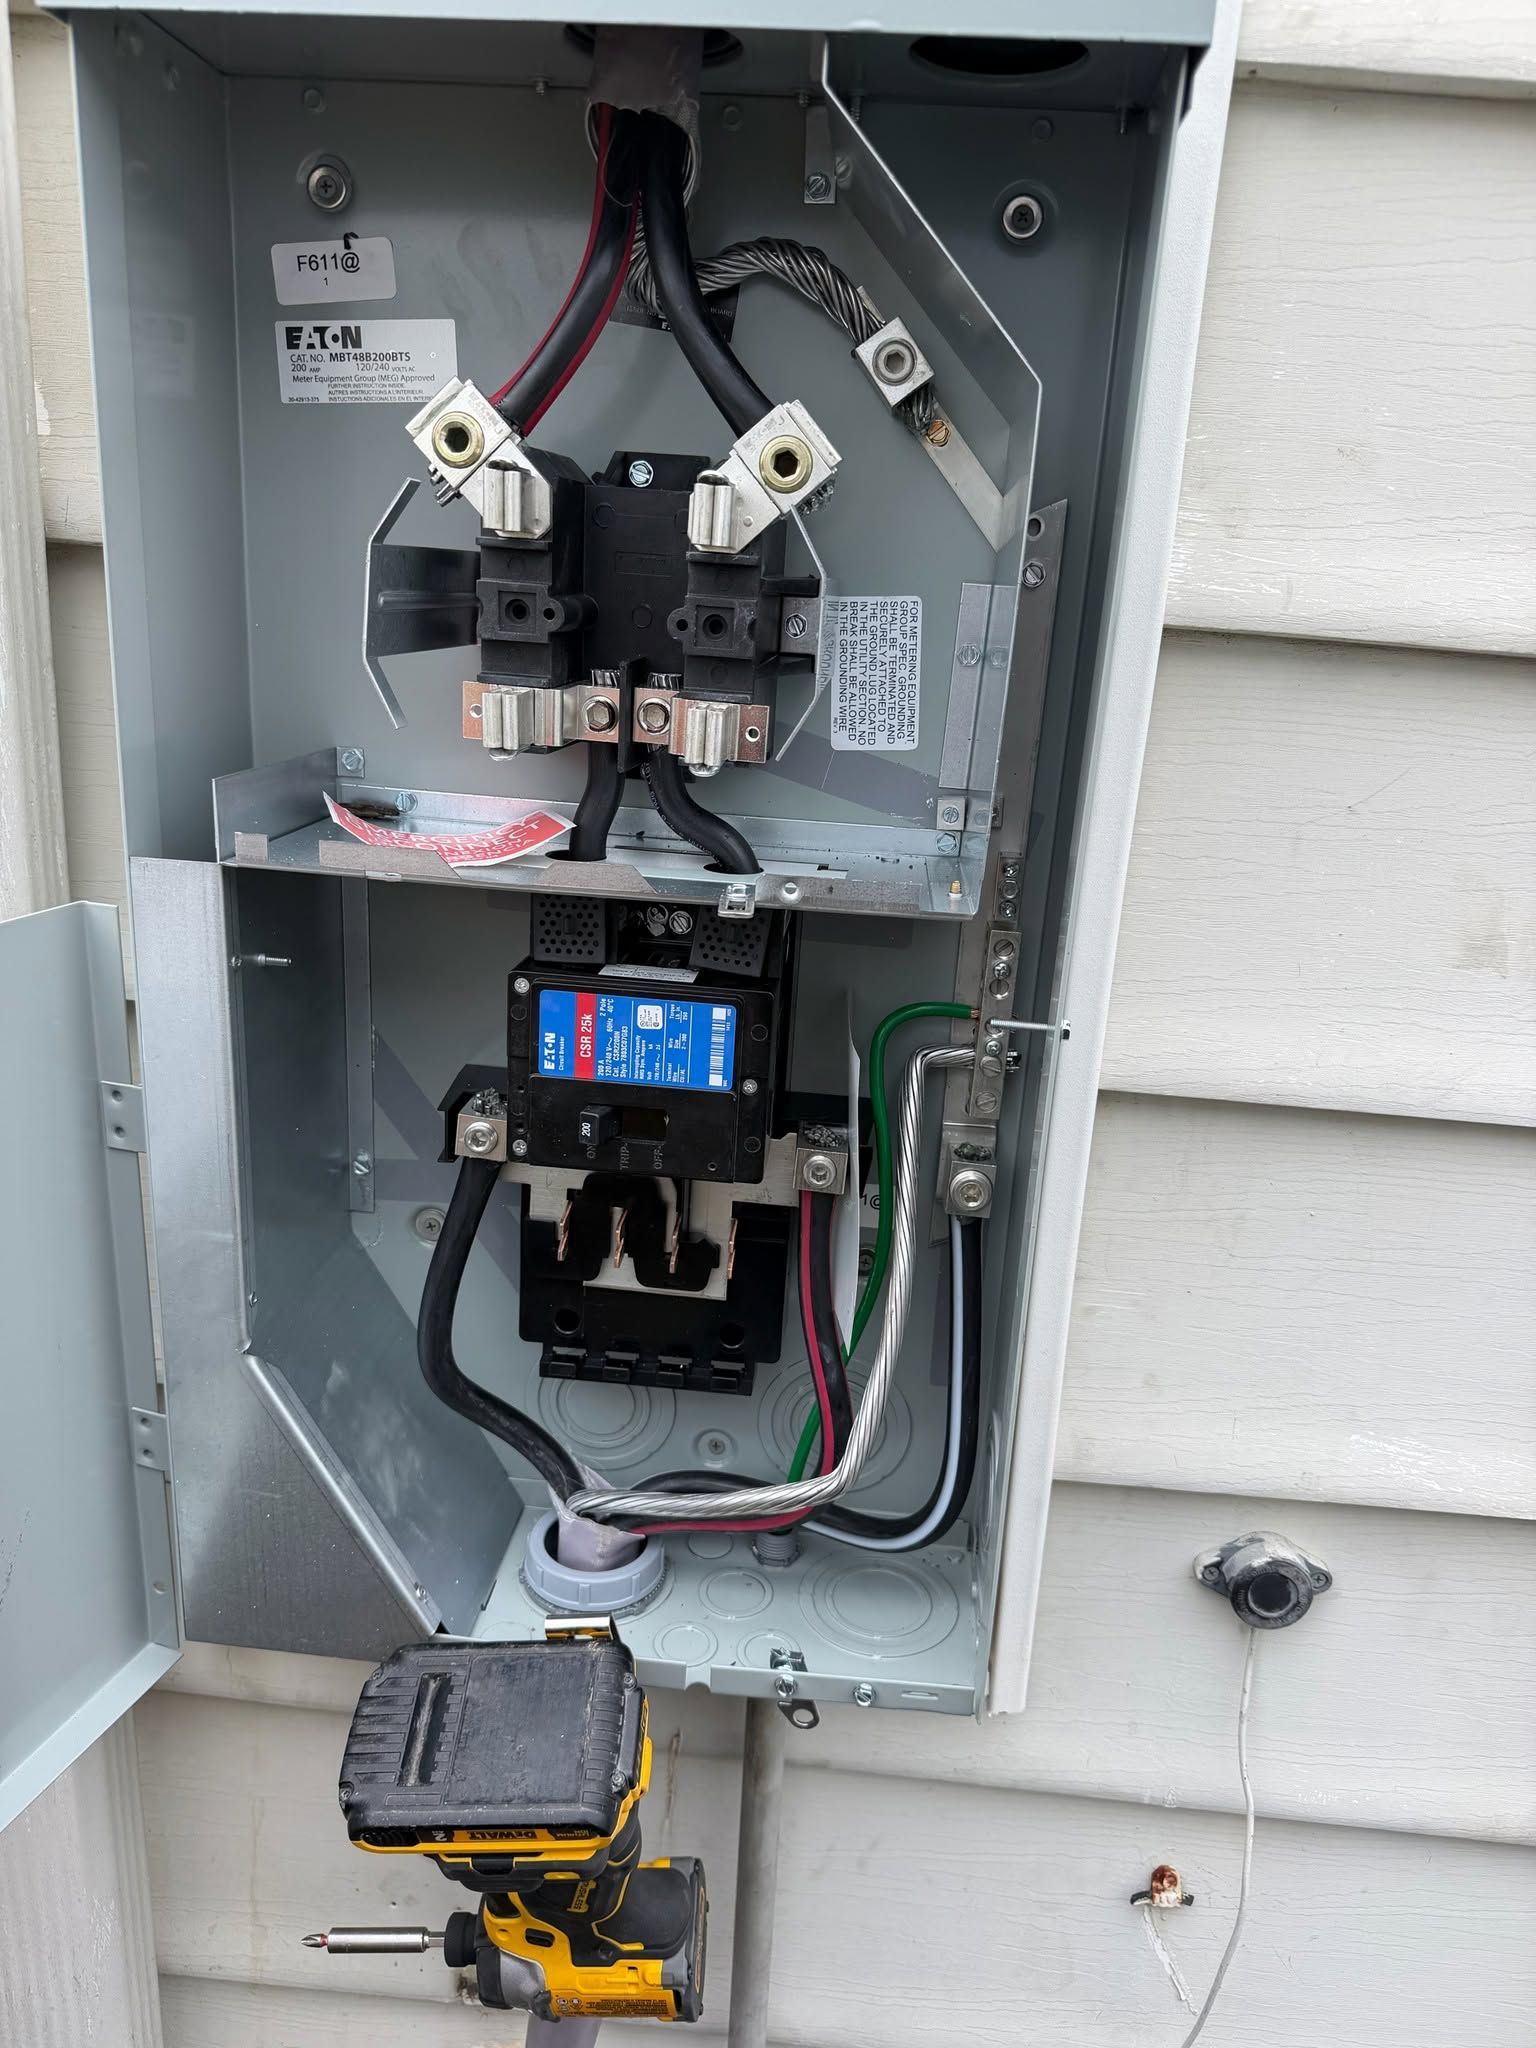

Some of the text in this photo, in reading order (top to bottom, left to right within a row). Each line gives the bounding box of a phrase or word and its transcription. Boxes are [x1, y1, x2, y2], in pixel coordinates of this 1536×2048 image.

[296, 251, 360, 273] F611@
[323, 277, 329, 286] 1
[285, 326, 362, 350] EATON
[290, 351, 411, 363] CAT. NO. MBT48B200BTS
[291, 363, 307, 372] 200
[356, 362, 390, 372] 120/240
[292, 373, 435, 384] Meter Equipment Group (MEG) Approved
[838, 601, 848, 732] IN THE GROUNDING WIRE
[847, 601, 858, 742] BREAK SHALL BE ALLOWED
[857, 601, 868, 746] IN THE UTILITY SECTION. NO
[867, 600, 879, 746] THE GROUND LUG LOCATED
[877, 601, 889, 733] SECURELY ATTACHED TO
[886, 600, 899, 745] SHALL BE TERMINATED AND
[896, 600, 909, 740] GROUP SPEC. GROUNDING
[906, 600, 919, 744] FOR METERING EQUIPMENT
[607, 998, 615, 1013] 40°C
[579, 1013, 593, 1058] CSR 25k
[606, 1017, 614, 1033] 60Hz
[543, 1032, 556, 1070] EATON
[597, 1064, 605, 1077] 200
[620, 1063, 628, 1078] Style
[581, 1122, 591, 1137] 200
[468, 1830, 538, 1841] DEWALT
